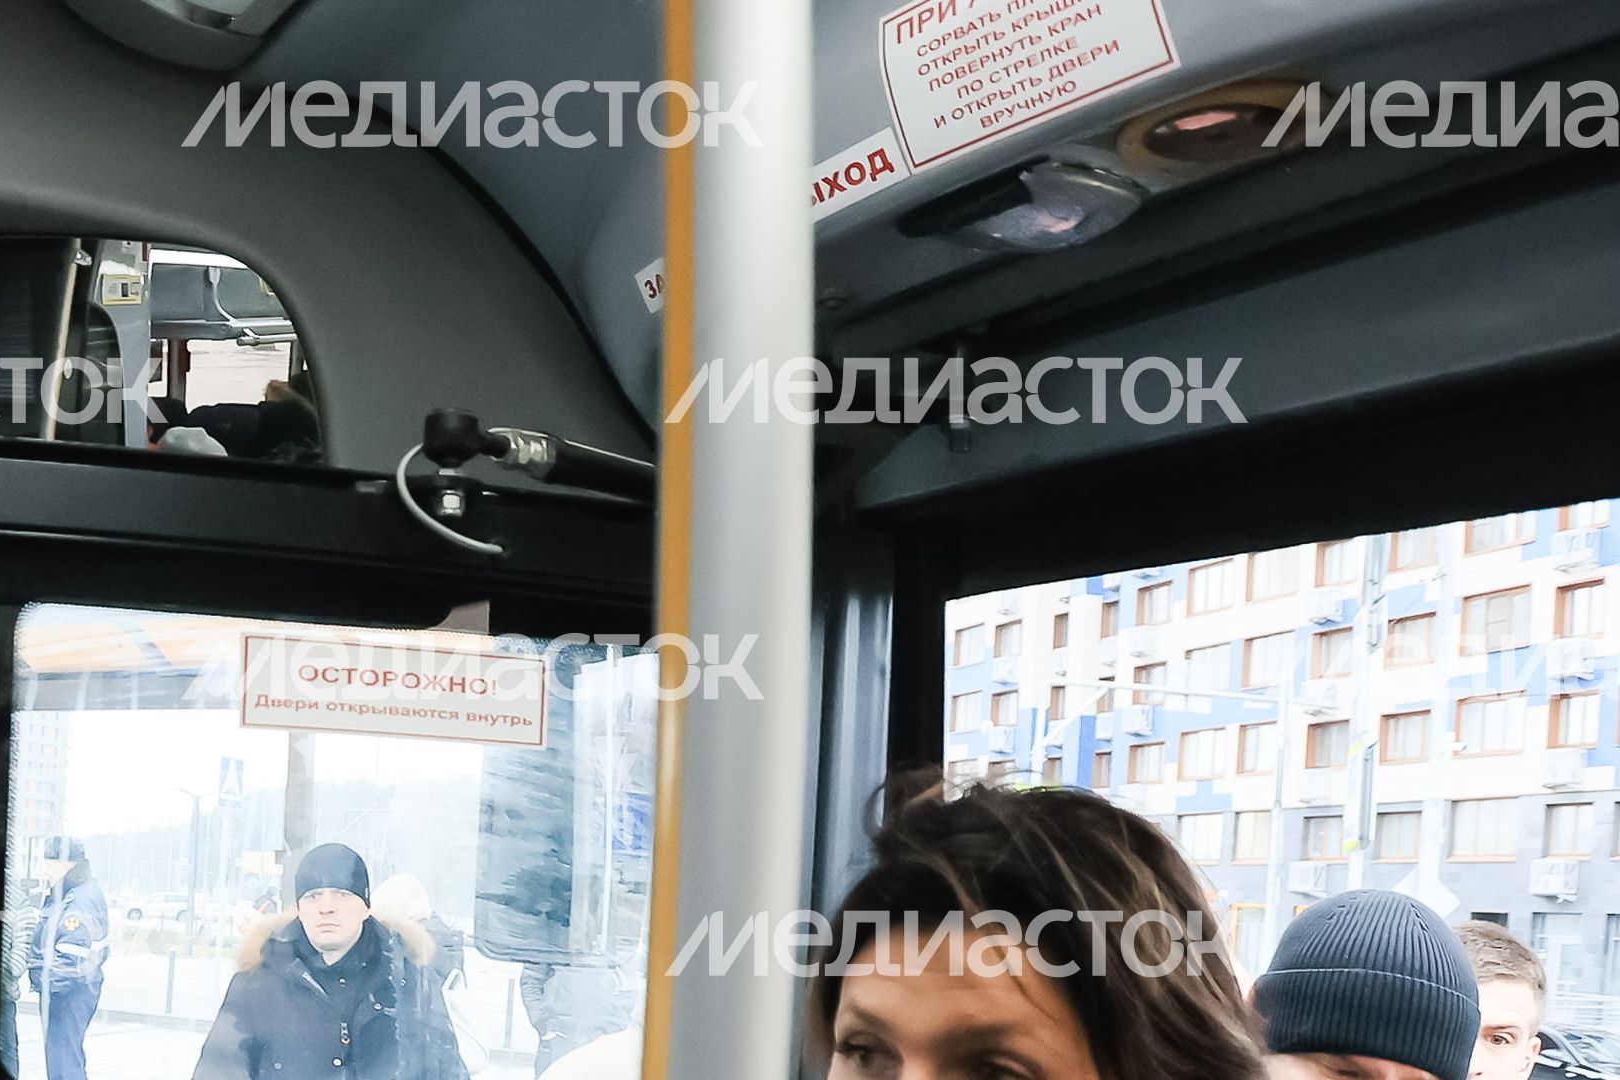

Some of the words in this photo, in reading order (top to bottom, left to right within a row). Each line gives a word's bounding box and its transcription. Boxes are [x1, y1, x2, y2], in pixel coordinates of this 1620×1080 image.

[897, 0, 957, 44] ПРИ
[917, 12, 1001, 57] СОРВАТЬ
[918, 31, 1005, 76] ОТКРЫТЬ
[1011, 0, 1082, 32] КРЫШ
[929, 35, 1042, 91] ПОВЕРНУТЬ
[1048, 3, 1102, 37] КРАН
[957, 79, 984, 99] ПО
[989, 36, 1079, 84] СТРЕЛКЕ
[934, 115, 946, 129] И
[951, 77, 1043, 120] ОТКРЫТЬ
[1048, 40, 1121, 82] ДВЕРИ
[980, 80, 1077, 129] ВРУЧНУЮ
[298, 665, 497, 696] ОСТОРОЖНО!
[254, 694, 319, 712] Двери
[326, 701, 459, 720] открываются
[466, 712, 533, 727] внутрь
